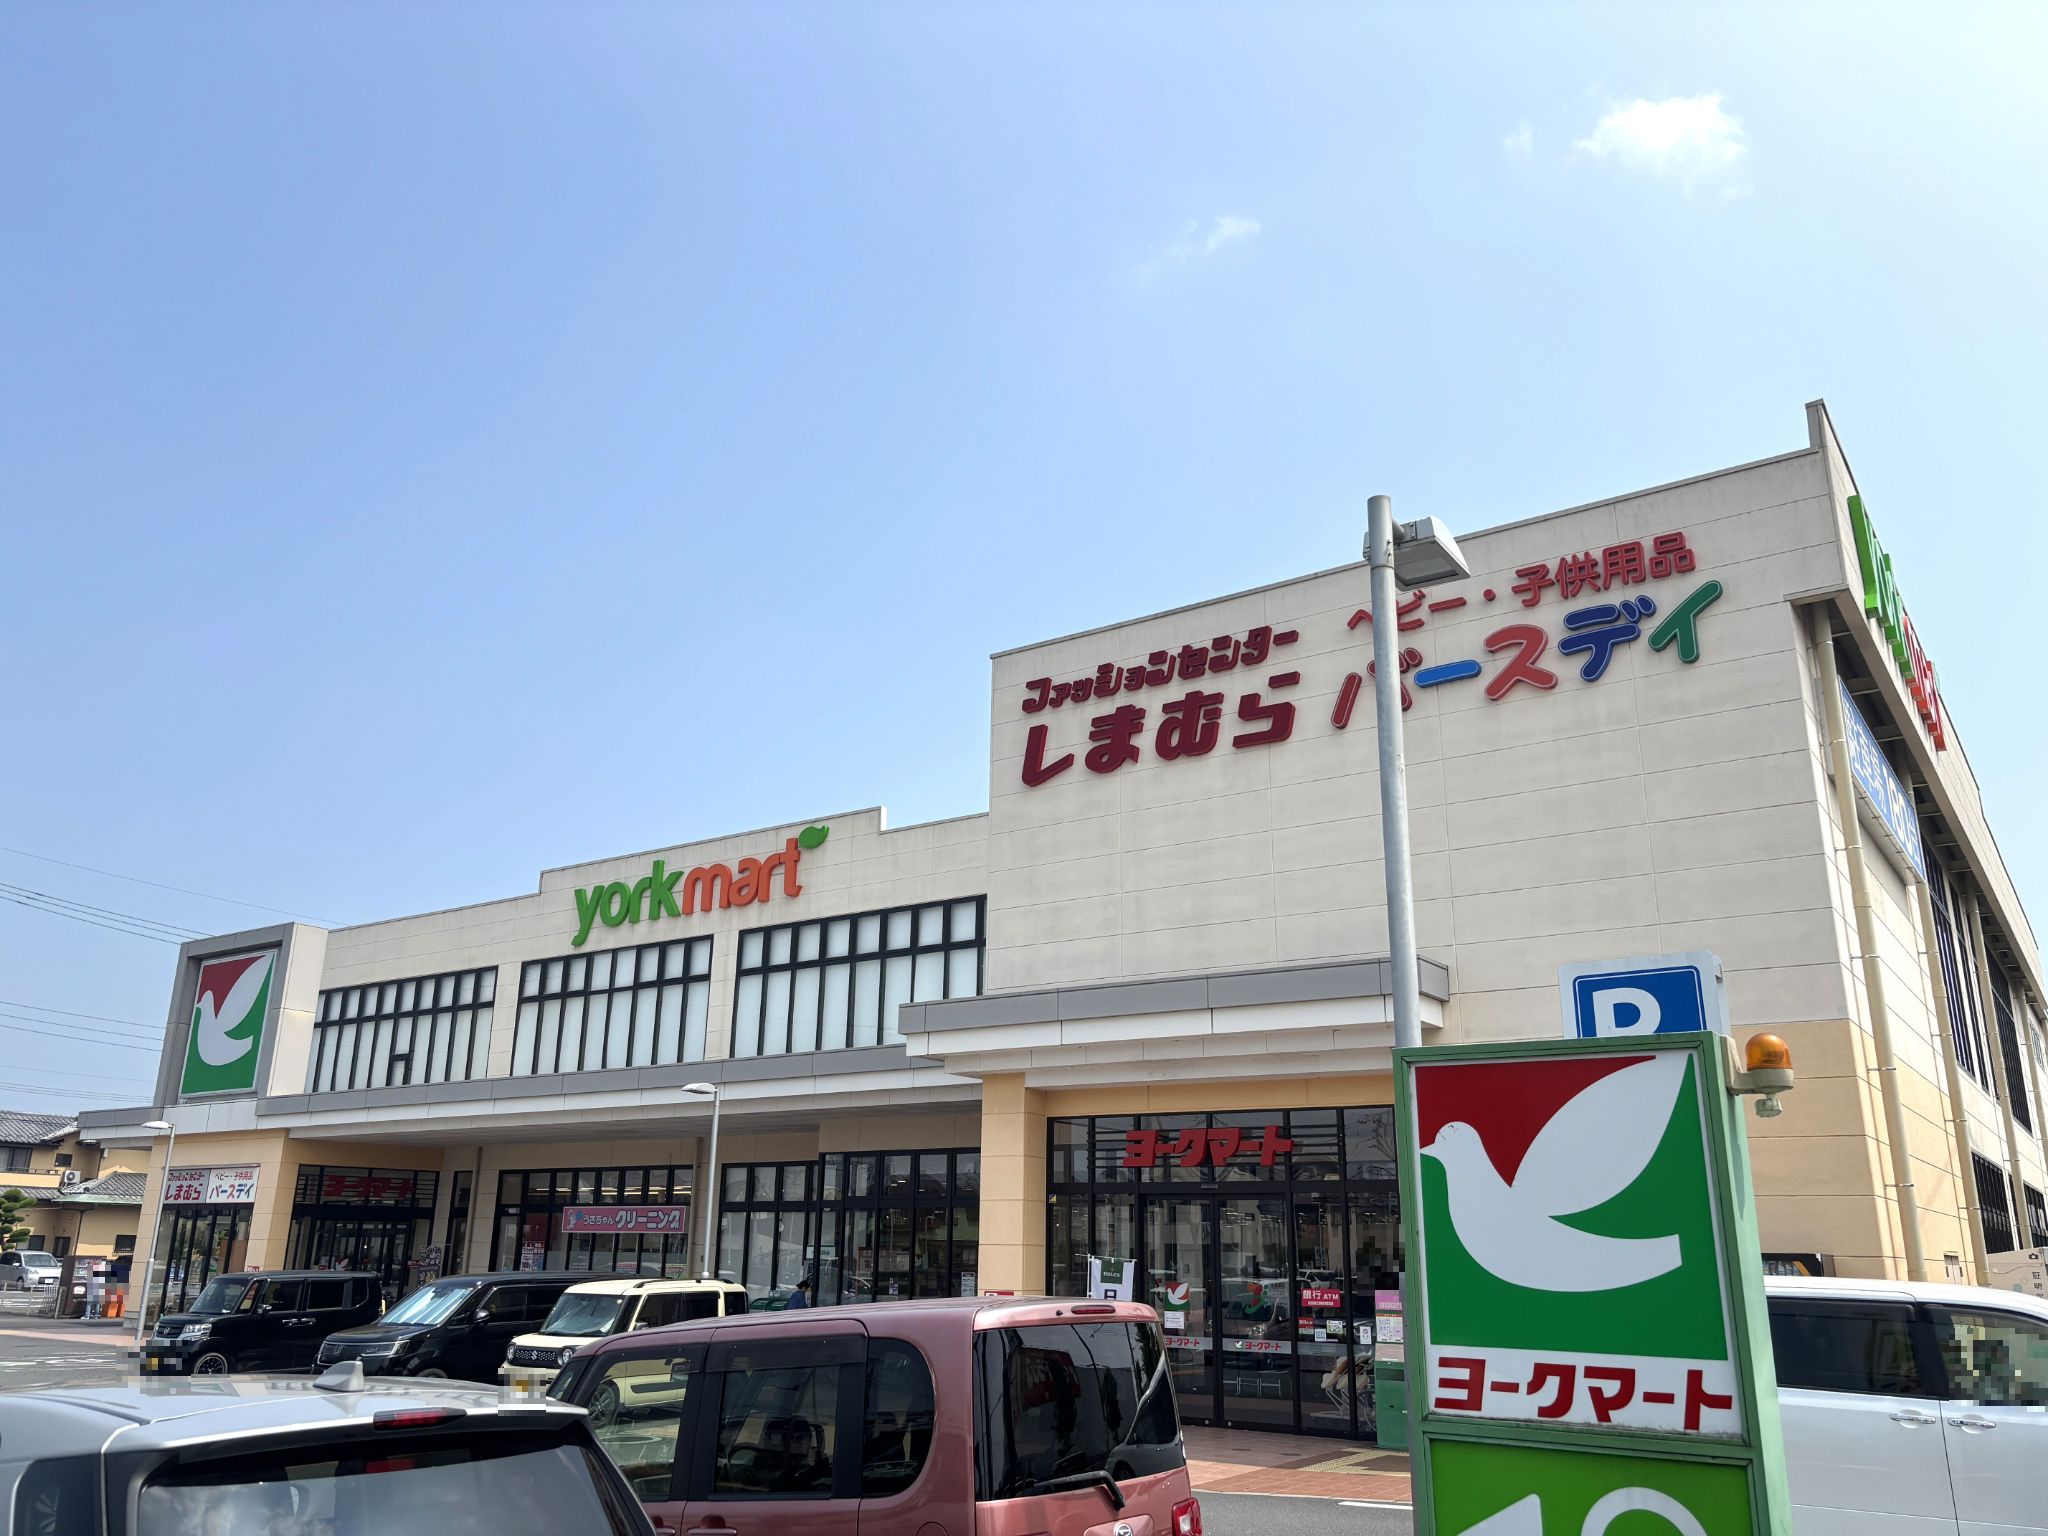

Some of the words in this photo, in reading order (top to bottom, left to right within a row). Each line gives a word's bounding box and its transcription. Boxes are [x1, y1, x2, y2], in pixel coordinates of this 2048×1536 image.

[1022, 626, 1299, 714] ファッションセンター
[1331, 579, 1723, 730] バースデイ
[1022, 671, 1301, 787] しまむら
[571, 838, 803, 947] yorkmart
[1592, 987, 1662, 1037] P
[1122, 1125, 1294, 1168] ヨークマート
[165, 1183, 204, 1201] しまむら
[209, 1183, 255, 1199] バースデイ
[1302, 1289, 1322, 1300] 銀行
[1165, 1337, 1200, 1347] ヨークマート
[1245, 1340, 1281, 1351] ヨークマート
[1434, 1357, 1733, 1430] ヨークマート
